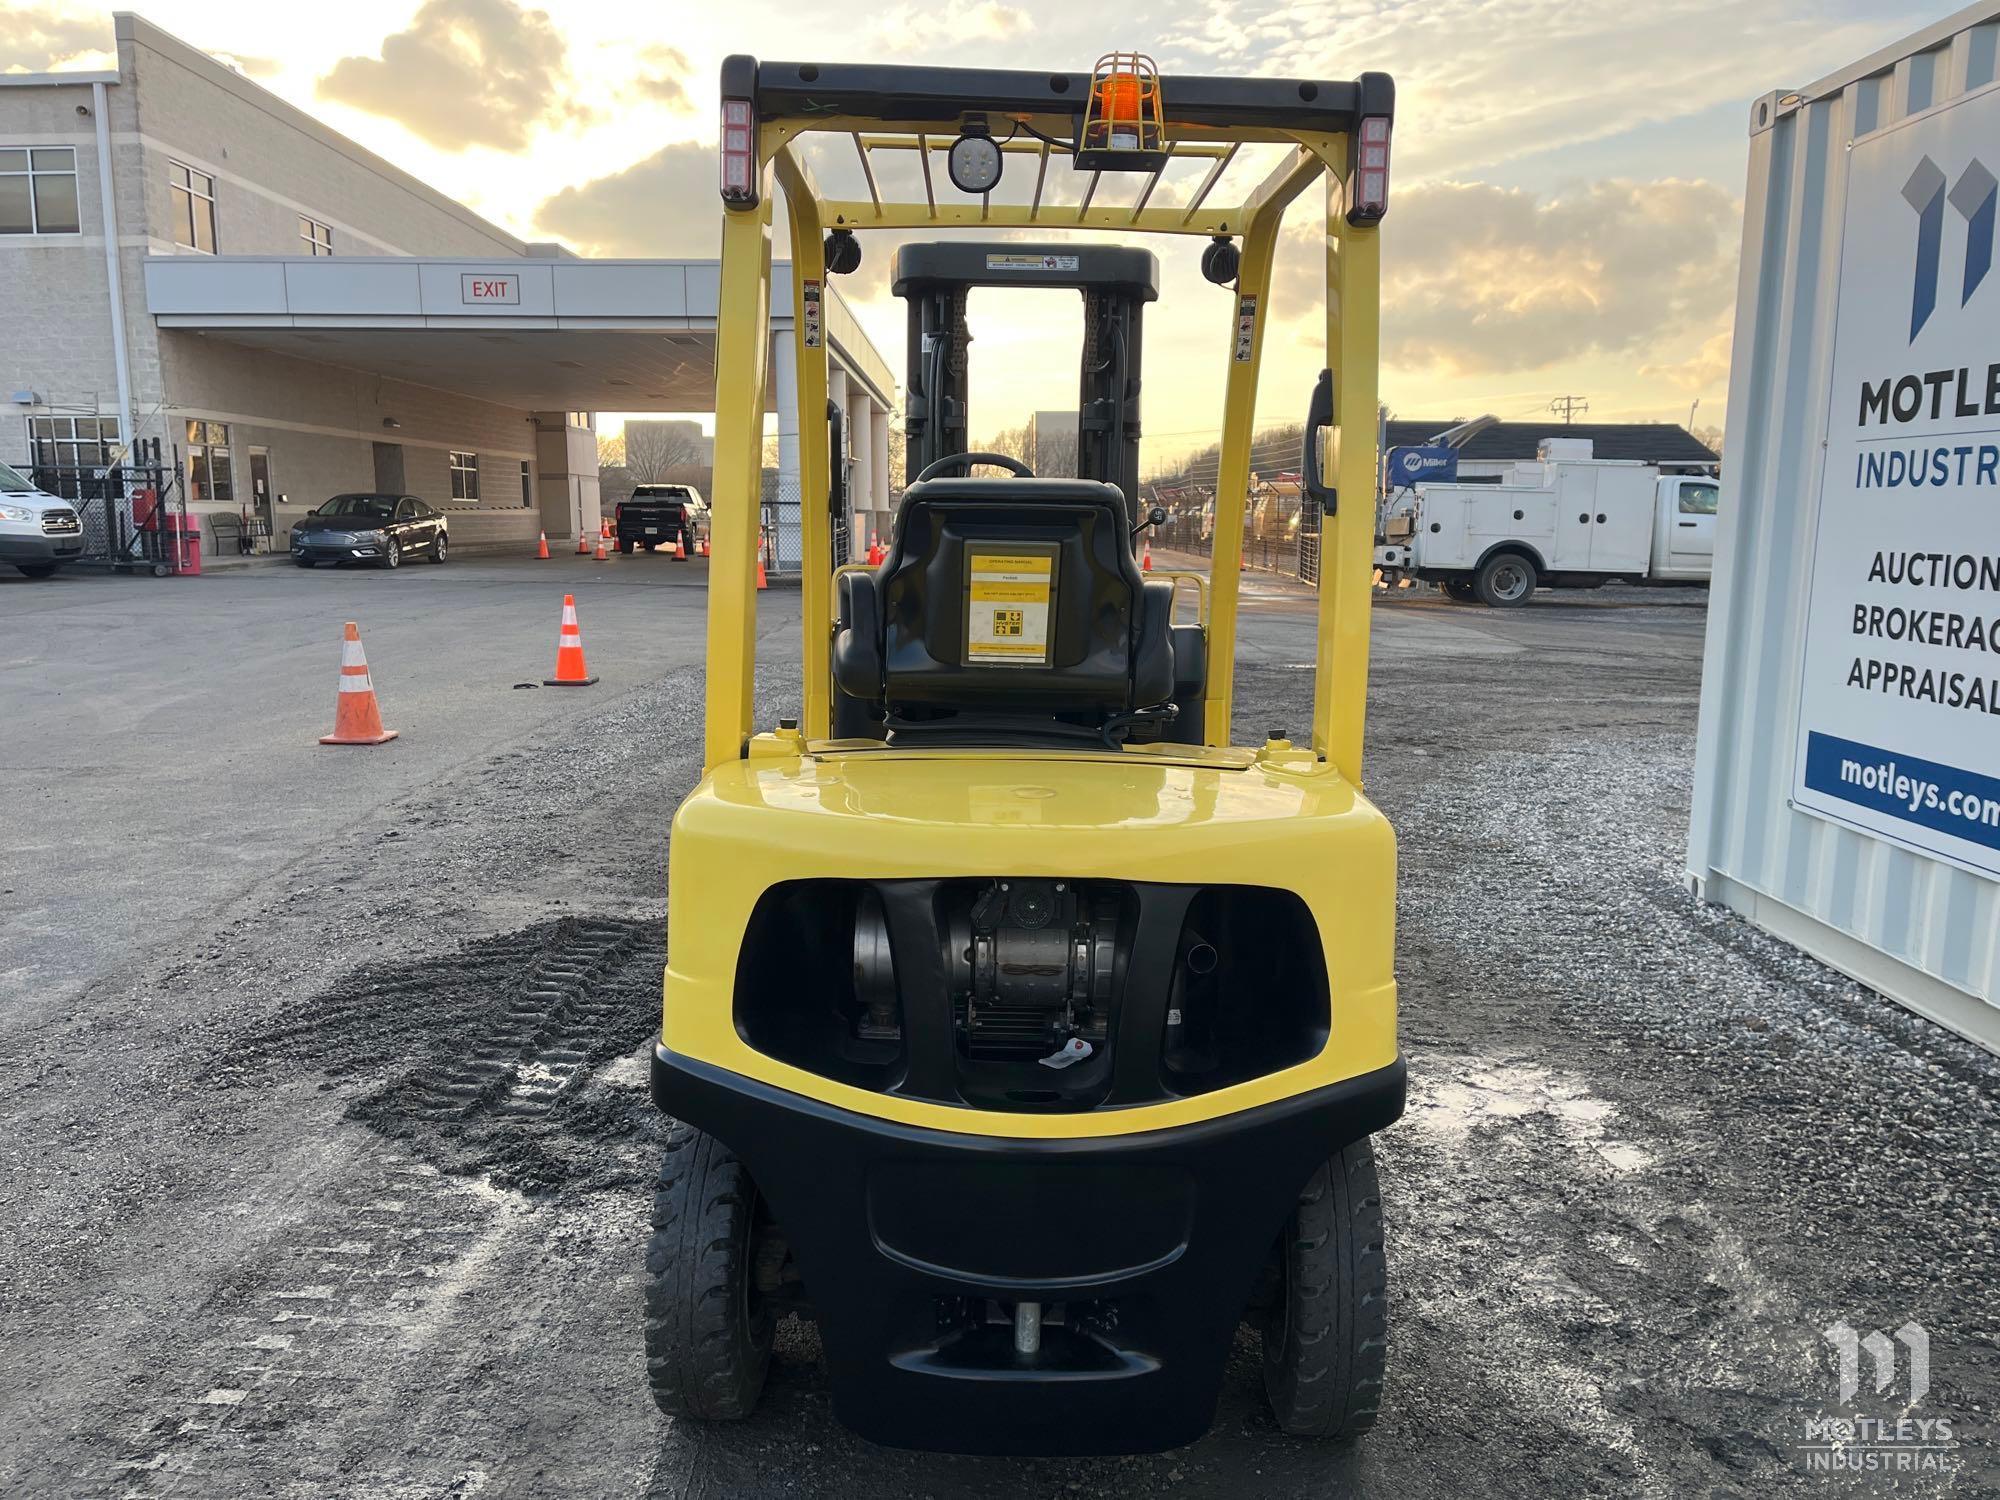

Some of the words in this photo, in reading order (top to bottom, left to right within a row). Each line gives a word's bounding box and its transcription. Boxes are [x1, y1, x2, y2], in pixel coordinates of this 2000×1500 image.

[473, 281, 508, 298] EXIT
[1858, 362, 2000, 427] MOTLE
[1422, 457, 1448, 467] Miller
[1856, 445, 2000, 489] INDUSTR
[1868, 551, 2000, 592] AUCTION
[1847, 657, 2000, 717] APPRAISAL
[1840, 758, 2000, 827] motleys.com
